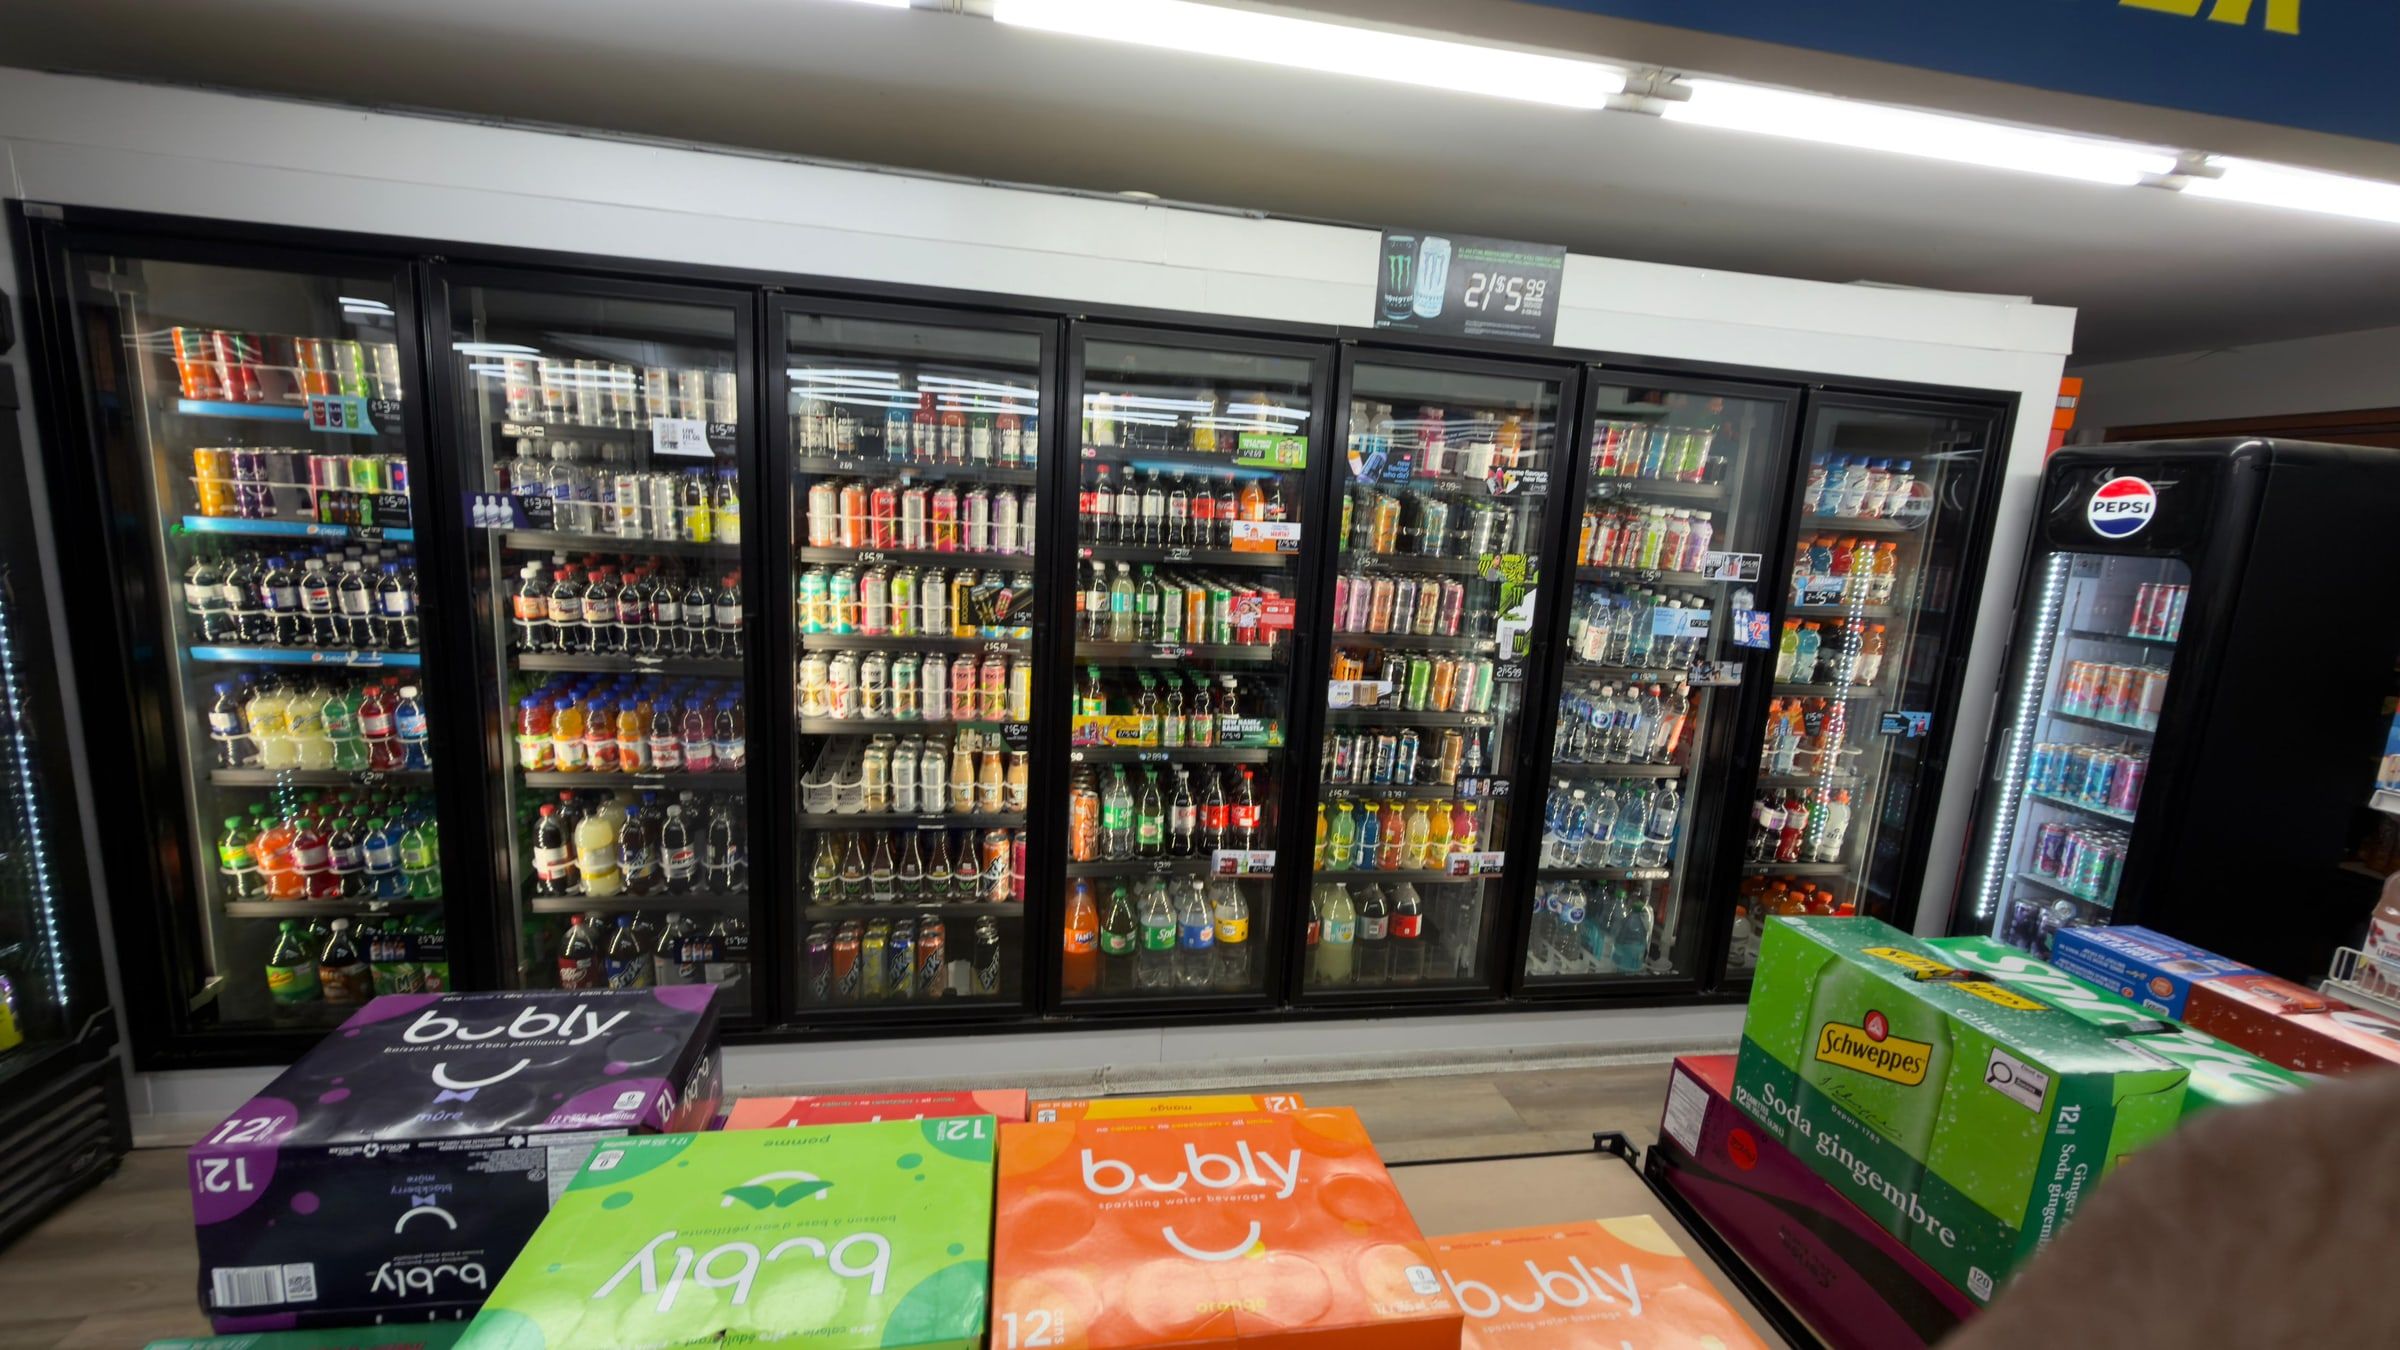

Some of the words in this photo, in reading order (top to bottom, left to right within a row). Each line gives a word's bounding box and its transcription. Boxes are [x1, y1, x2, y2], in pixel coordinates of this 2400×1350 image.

[2092, 501, 2150, 514] PEPSI
[402, 1003, 632, 1046] bubly
[1821, 1029, 1921, 1075] Schweppes
[656, 1088, 676, 1124] 12
[1269, 1096, 1298, 1112] 12
[1736, 1085, 1748, 1103] 12
[1150, 1103, 1193, 1112] mango
[1830, 1104, 1860, 1128] Depuis
[2058, 1104, 2081, 1123] 12
[208, 1116, 266, 1144] 12
[763, 1134, 832, 1147] pomme
[946, 1119, 987, 1141] 12
[1081, 1140, 1302, 1200] bubly
[1762, 1083, 1812, 1138] Soda
[1815, 1130, 1957, 1249] gingembre
[2054, 1143, 2077, 1181] Soda
[202, 1157, 254, 1192] 12
[2064, 1162, 2089, 1215] Ginger
[1098, 1199, 1160, 1211] sparkling
[1165, 1195, 1202, 1206] water
[1206, 1192, 1266, 1204] beverage
[751, 1219, 791, 1231] d'eau
[796, 1217, 830, 1229] base
[846, 1214, 897, 1225] boisson
[370, 1261, 488, 1298] bubly
[590, 1229, 891, 1314] bubly
[1972, 1269, 1990, 1288] 120
[1441, 1255, 1643, 1318] bubly
[1195, 1297, 1267, 1314] orange
[1001, 1308, 1051, 1349] 12
[1483, 1319, 1536, 1334] sparkling
[1537, 1316, 1569, 1329] water
[1570, 1310, 1622, 1323] beverage
